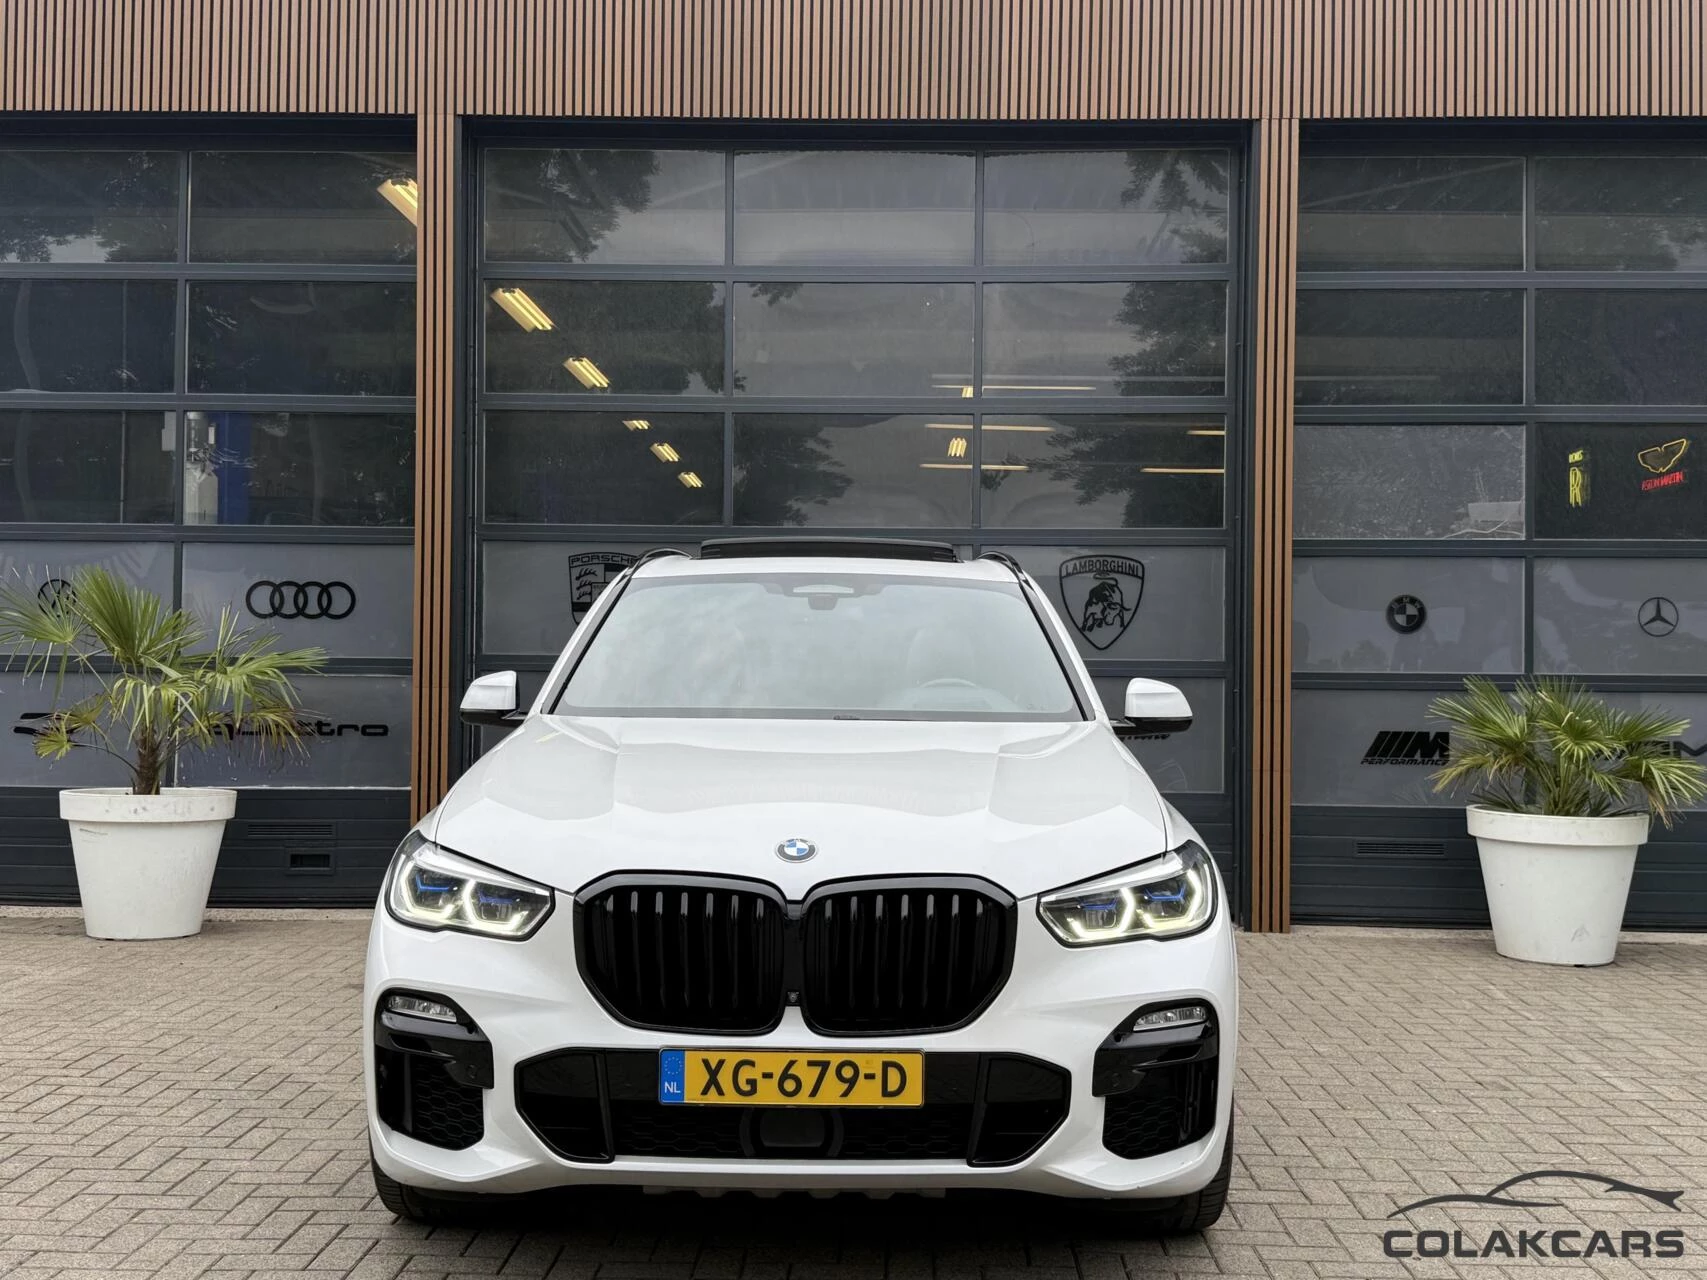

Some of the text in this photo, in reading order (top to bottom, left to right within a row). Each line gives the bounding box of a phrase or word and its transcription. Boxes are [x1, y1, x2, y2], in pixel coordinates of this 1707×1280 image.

[1065, 559, 1139, 577] LAMBORGHINI
[700, 1058, 907, 1098] XG-679-D
[664, 1081, 681, 1094] NL
